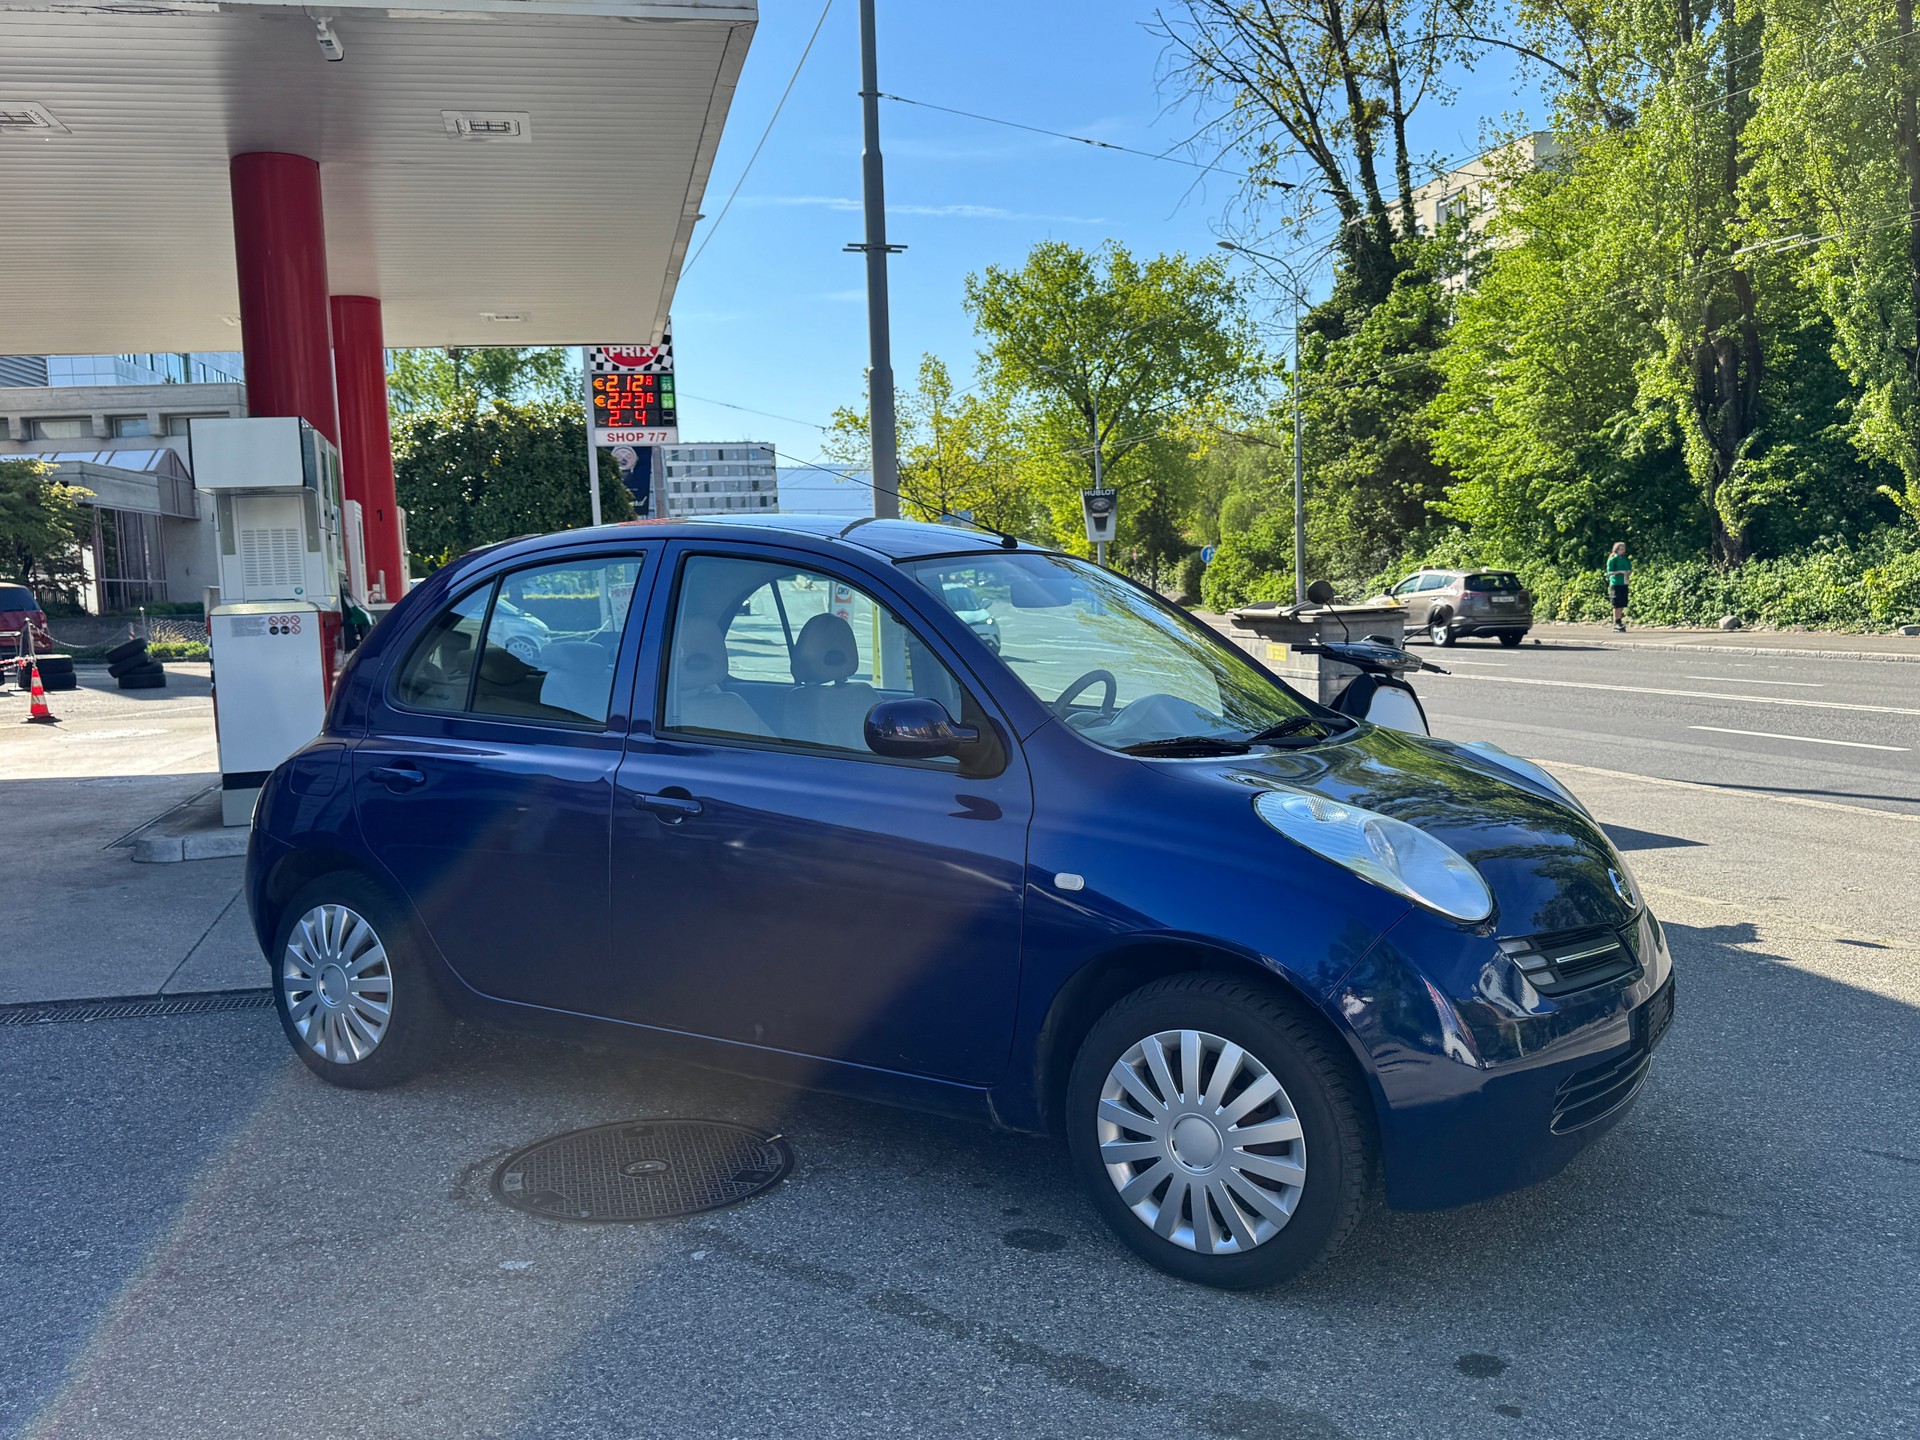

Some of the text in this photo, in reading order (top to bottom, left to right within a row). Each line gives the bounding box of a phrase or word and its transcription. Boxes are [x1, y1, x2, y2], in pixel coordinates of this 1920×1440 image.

[608, 346, 654, 357] PRIX
[607, 432, 667, 442] SHOP 7/7
[377, 509, 383, 521] 1
